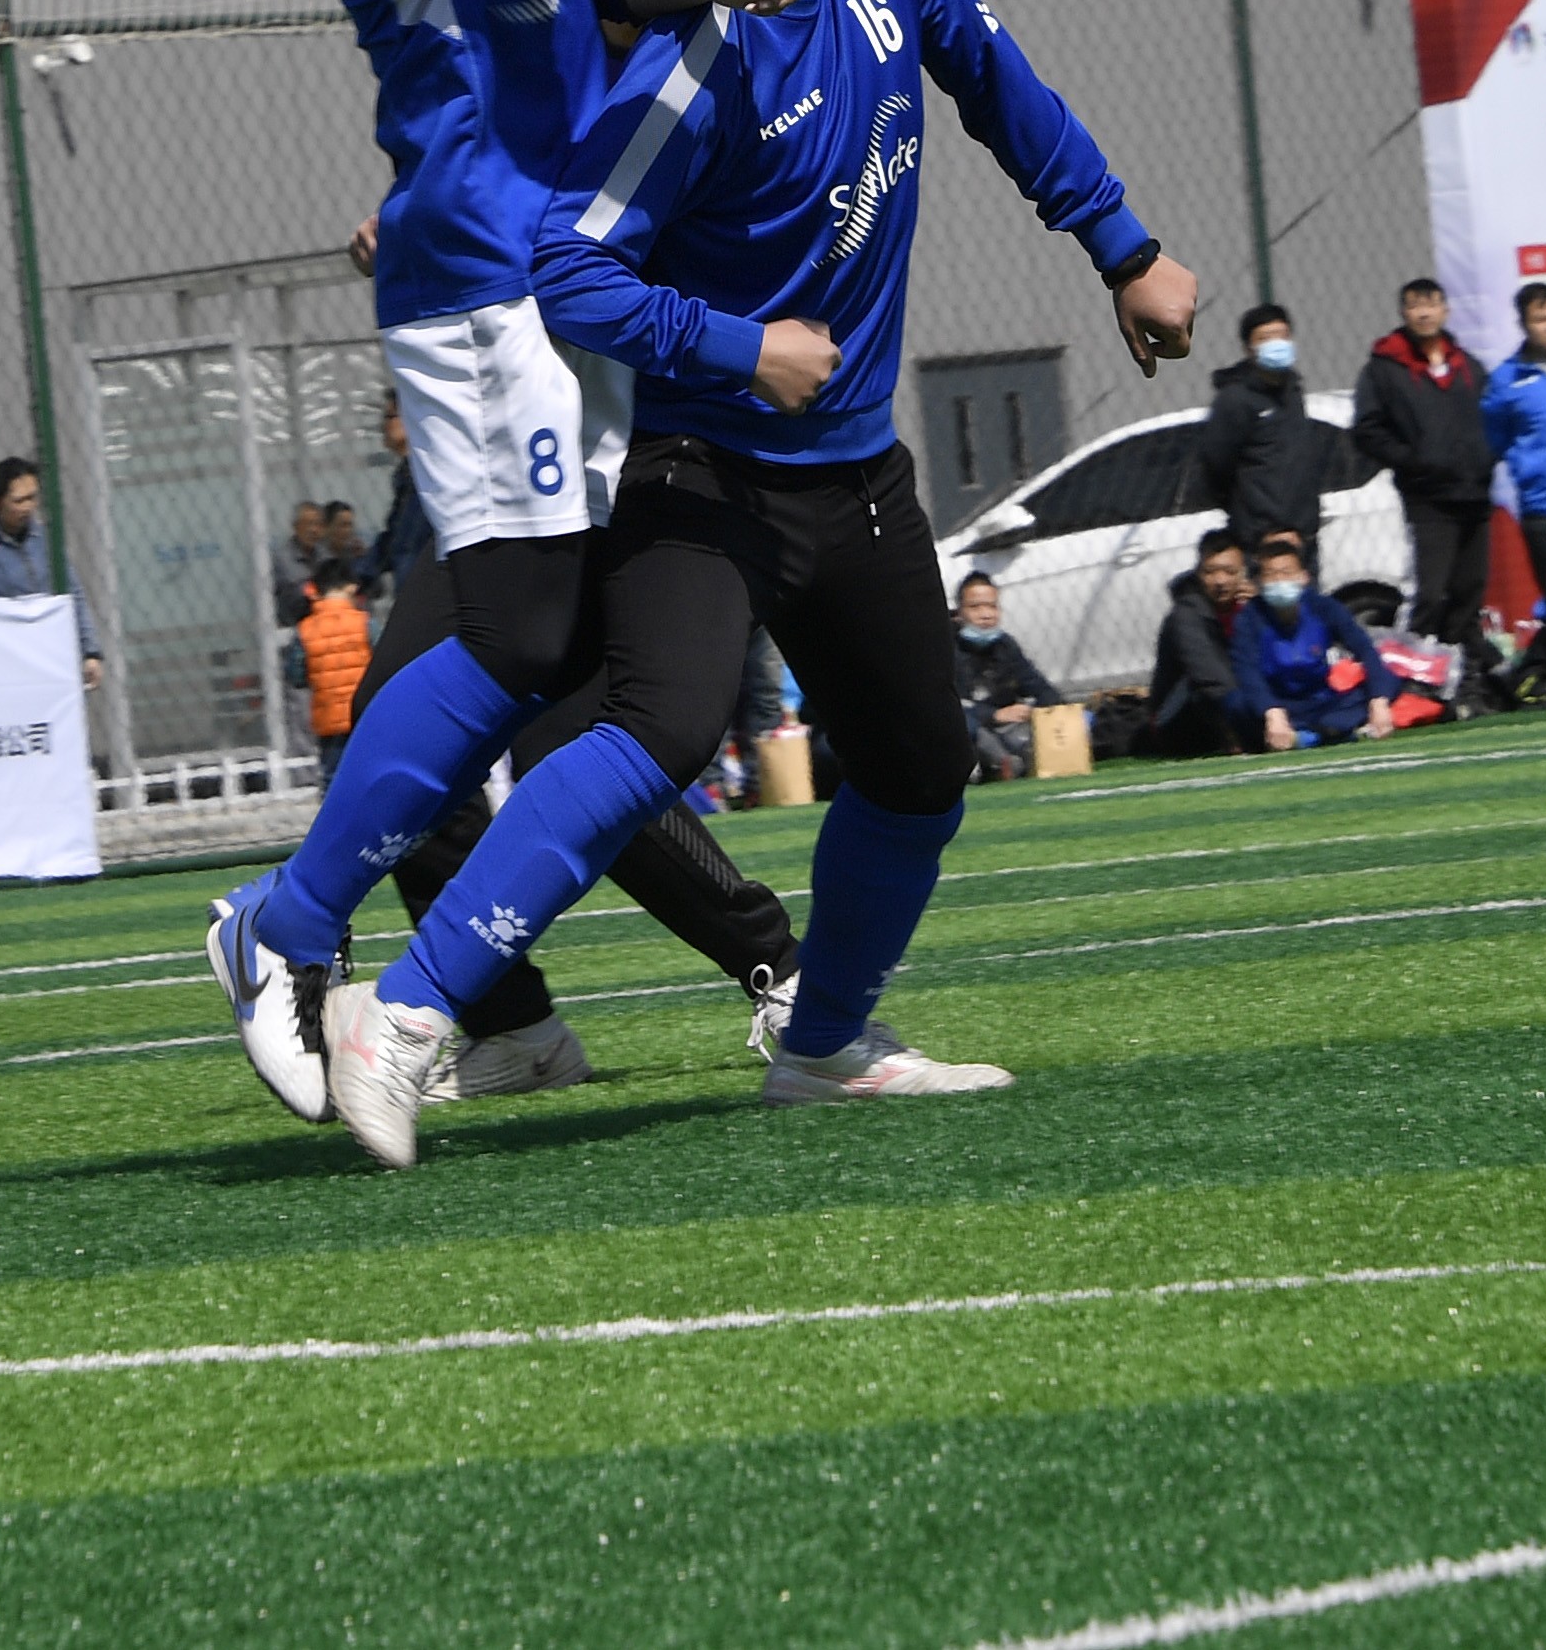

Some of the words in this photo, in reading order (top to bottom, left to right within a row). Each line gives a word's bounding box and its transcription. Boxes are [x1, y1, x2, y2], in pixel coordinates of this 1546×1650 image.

[759, 88, 825, 141] KELME
[529, 428, 563, 496] 8
[467, 915, 516, 958] KELME
